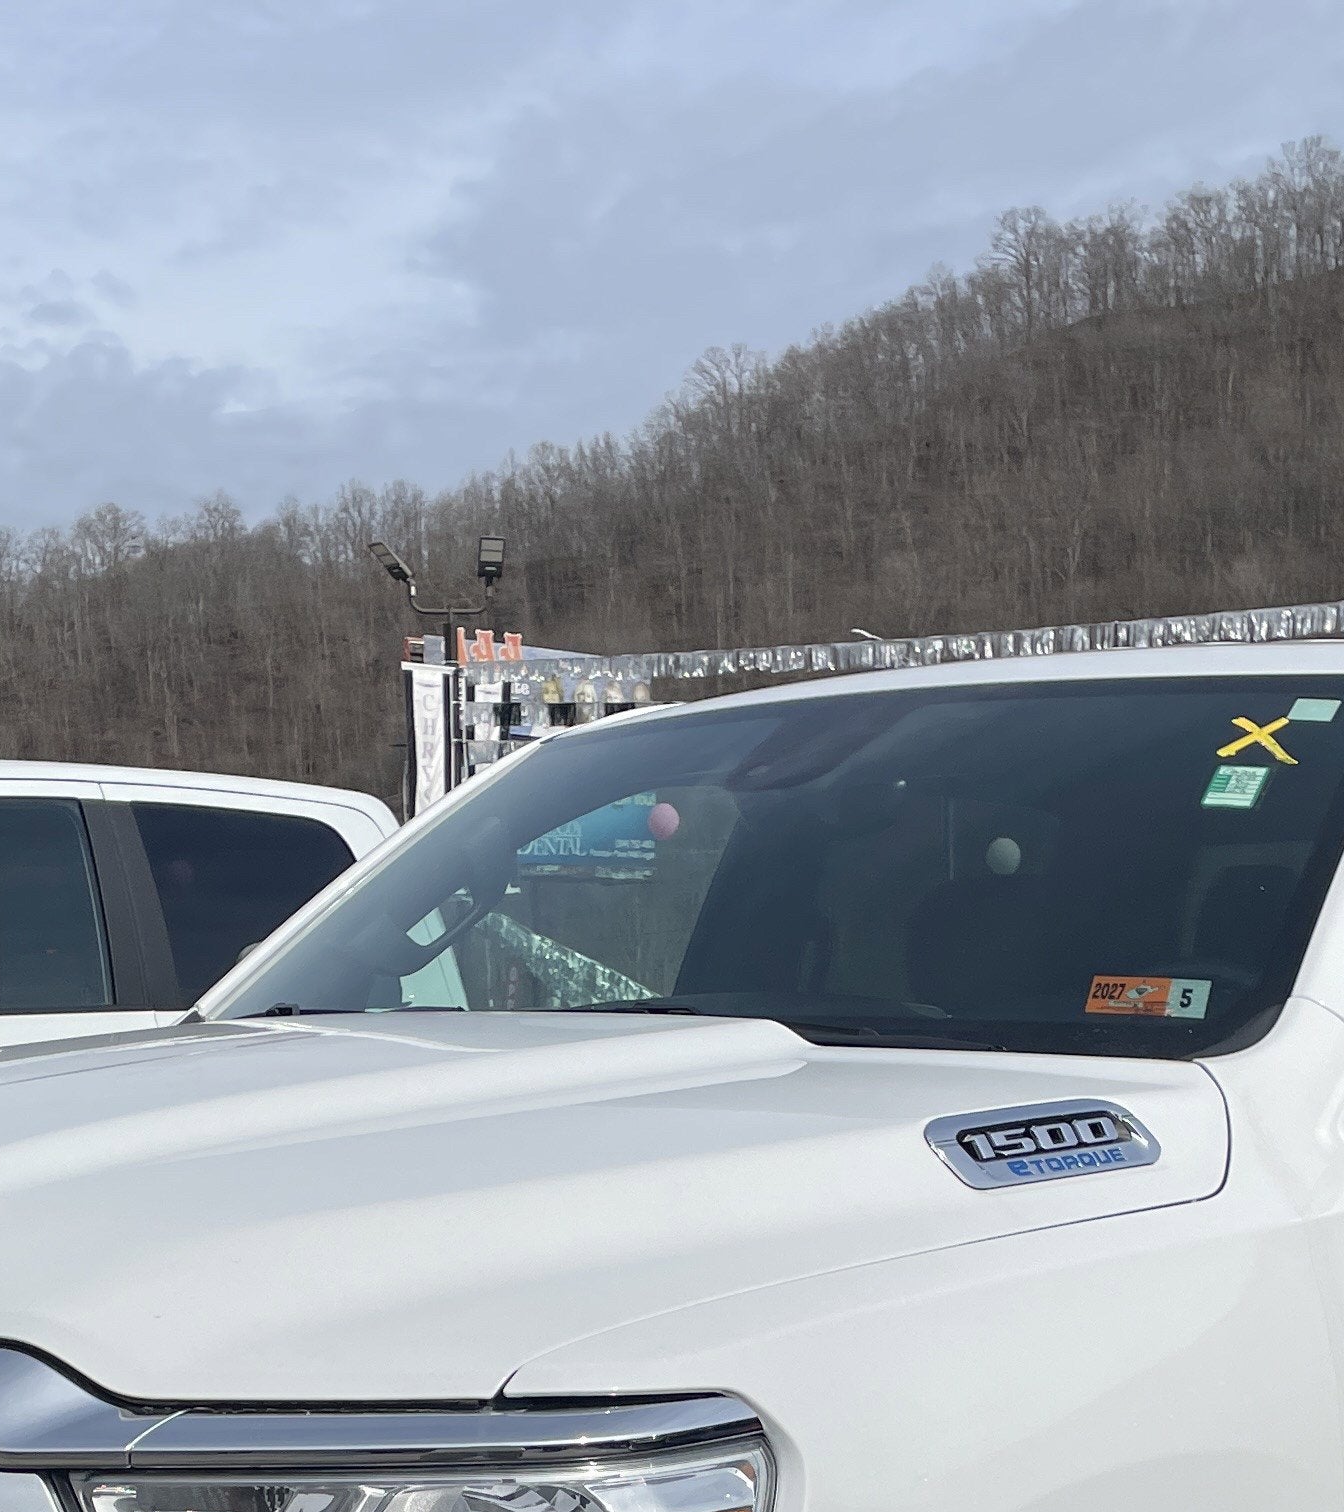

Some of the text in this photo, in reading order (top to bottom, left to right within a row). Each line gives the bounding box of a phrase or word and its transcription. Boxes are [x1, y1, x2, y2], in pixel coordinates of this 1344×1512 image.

[1092, 983, 1194, 1009] 2027 5
[963, 1116, 1120, 1160] 1500
